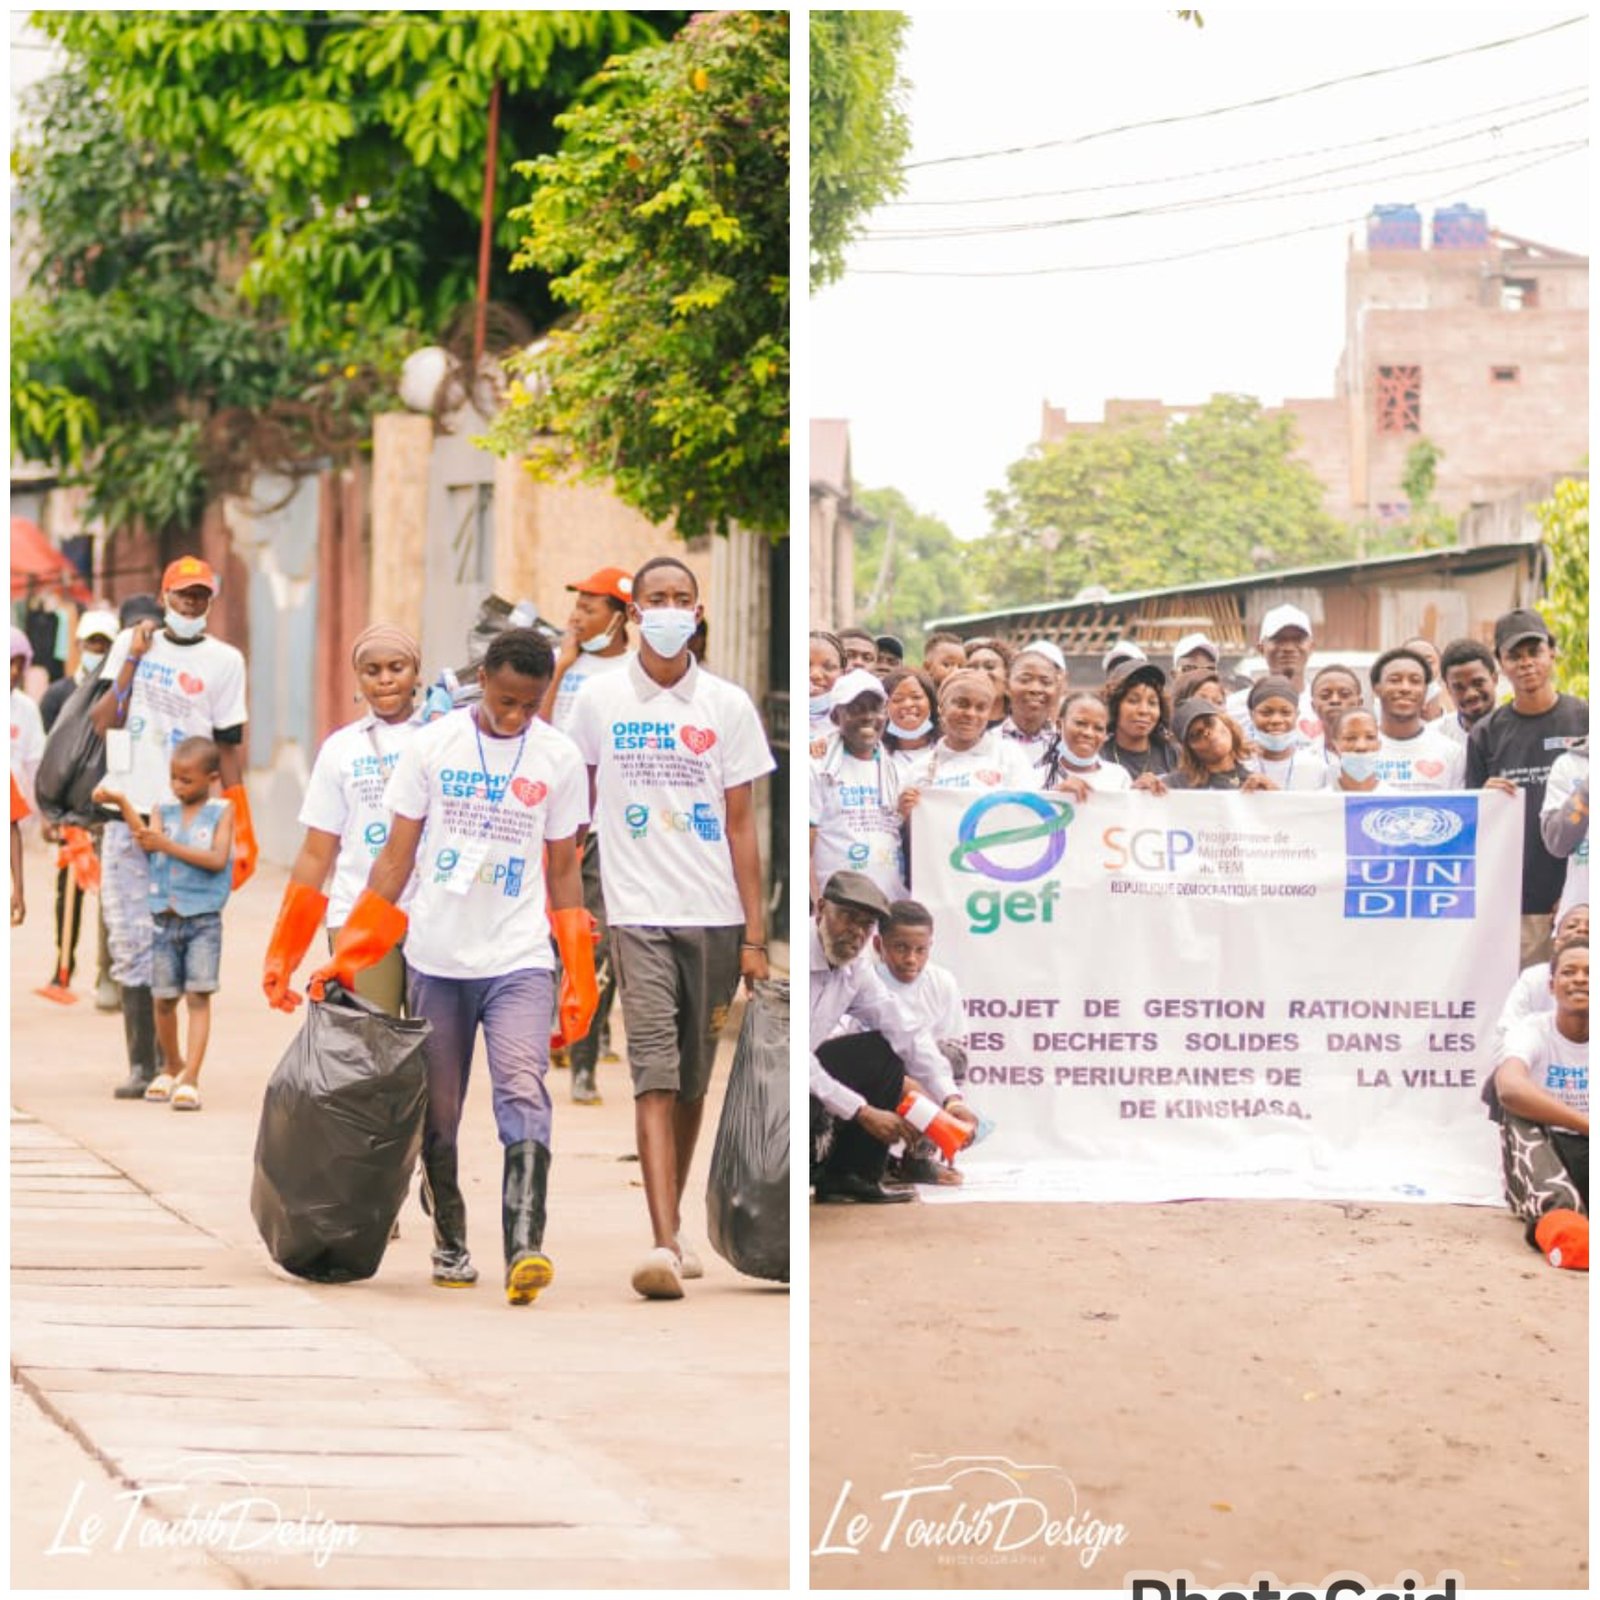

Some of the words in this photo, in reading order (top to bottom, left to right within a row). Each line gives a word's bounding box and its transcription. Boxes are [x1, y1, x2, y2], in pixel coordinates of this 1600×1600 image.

[613, 721, 675, 736] ORPH'
[1102, 826, 1195, 871] SGP
[1217, 861, 1245, 873] FEM
[1279, 884, 1316, 896] CONGO
[966, 880, 1060, 934] gef
[963, 999, 1060, 1018] ROJET
[1084, 999, 1120, 1018] DE
[1144, 999, 1265, 1019] GESTION
[1289, 1000, 1476, 1019] RATIONNELLE
[1033, 1032, 1158, 1051] DECHETS
[1185, 1033, 1299, 1052] SOLIDES
[1327, 1033, 1402, 1052] DANS
[1429, 1033, 1476, 1052] LES
[963, 1065, 1044, 1086] ONES
[1055, 1066, 1254, 1086] PERIURBAINES
[1266, 1068, 1301, 1086] DE
[1357, 1069, 1391, 1087] LA
[1403, 1069, 1476, 1088] VILLE
[1120, 1100, 1156, 1119] DE
[1165, 1099, 1312, 1120] KINSHASA.
